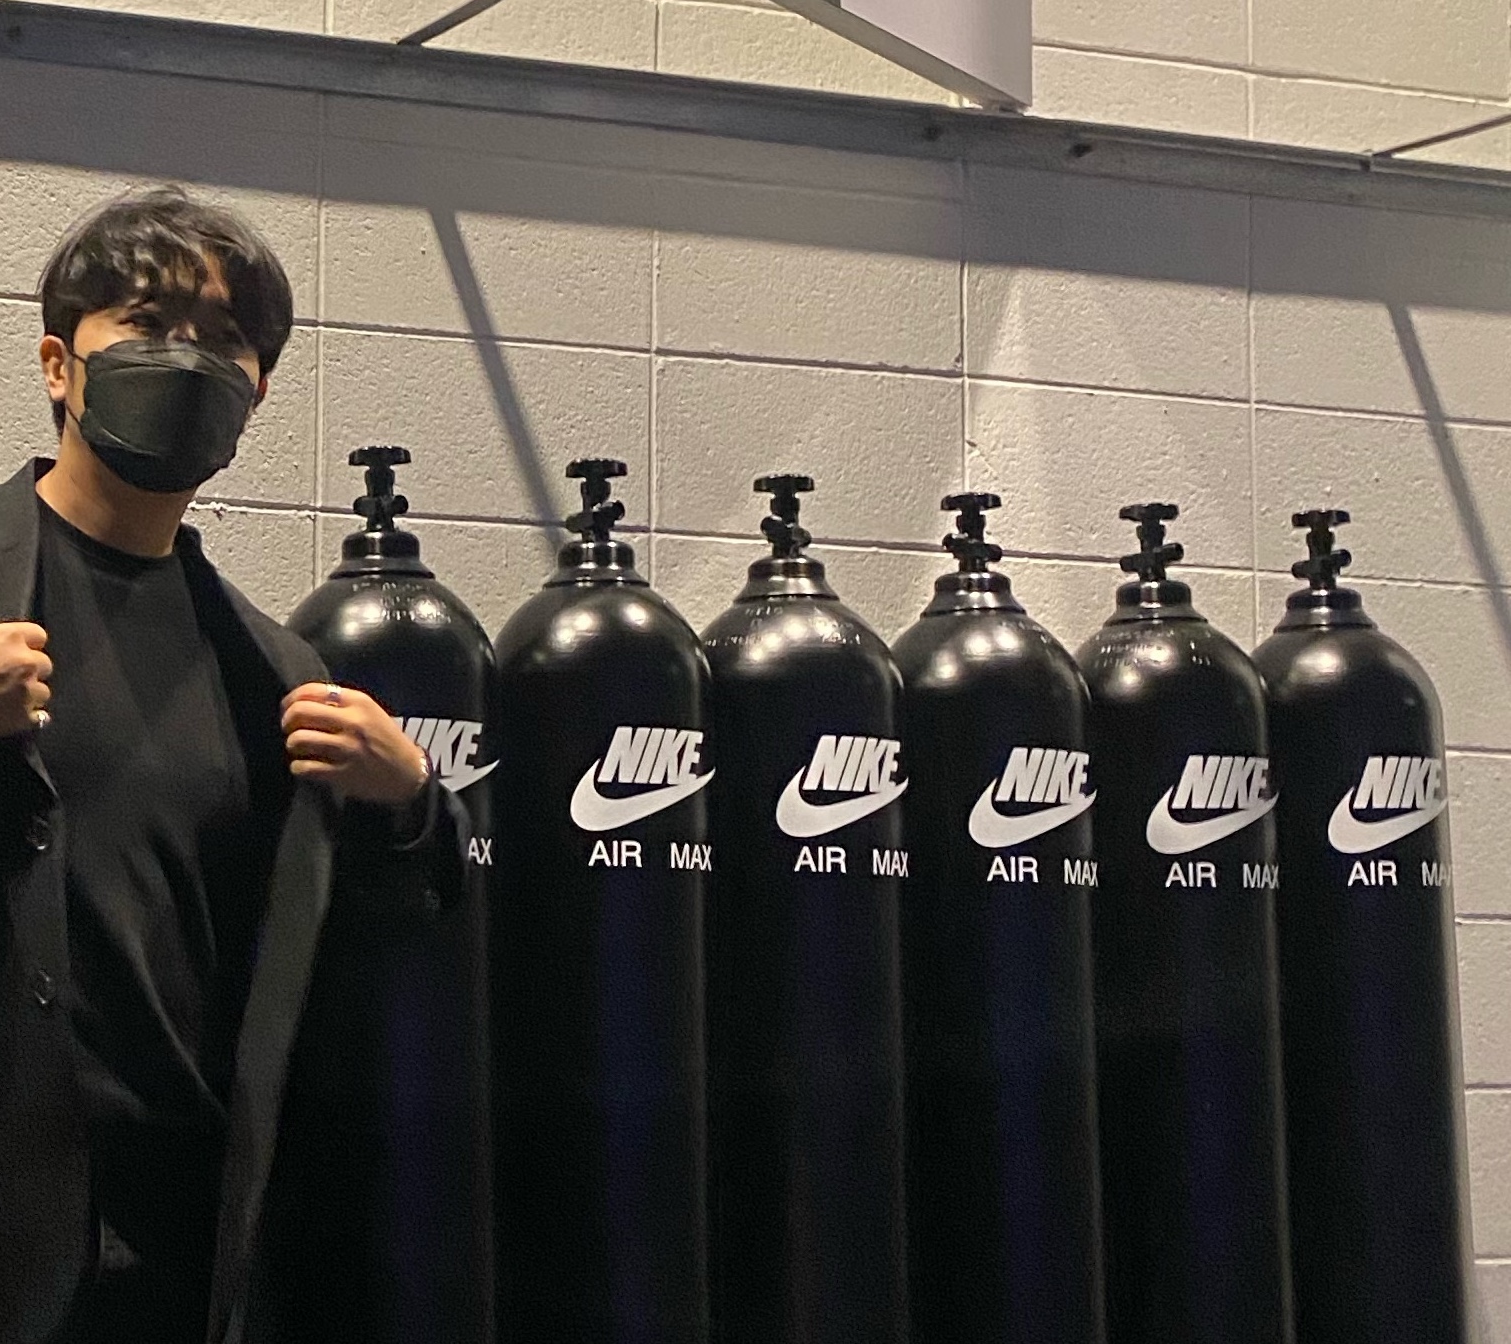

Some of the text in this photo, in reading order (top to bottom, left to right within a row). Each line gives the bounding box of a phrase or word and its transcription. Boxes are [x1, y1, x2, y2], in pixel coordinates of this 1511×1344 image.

[597, 726, 704, 785] NIKE
[802, 735, 901, 793] NIKE
[995, 746, 1090, 804] NIKE
[1171, 755, 1269, 810] NIKE
[1353, 756, 1441, 810] NIKE
[588, 840, 712, 872] AIR MAX
[794, 846, 909, 878] AIR MAX
[986, 856, 1099, 888] AIR MAX
[1165, 861, 1279, 890] AIR MAX
[1347, 860, 1398, 887] AIR
